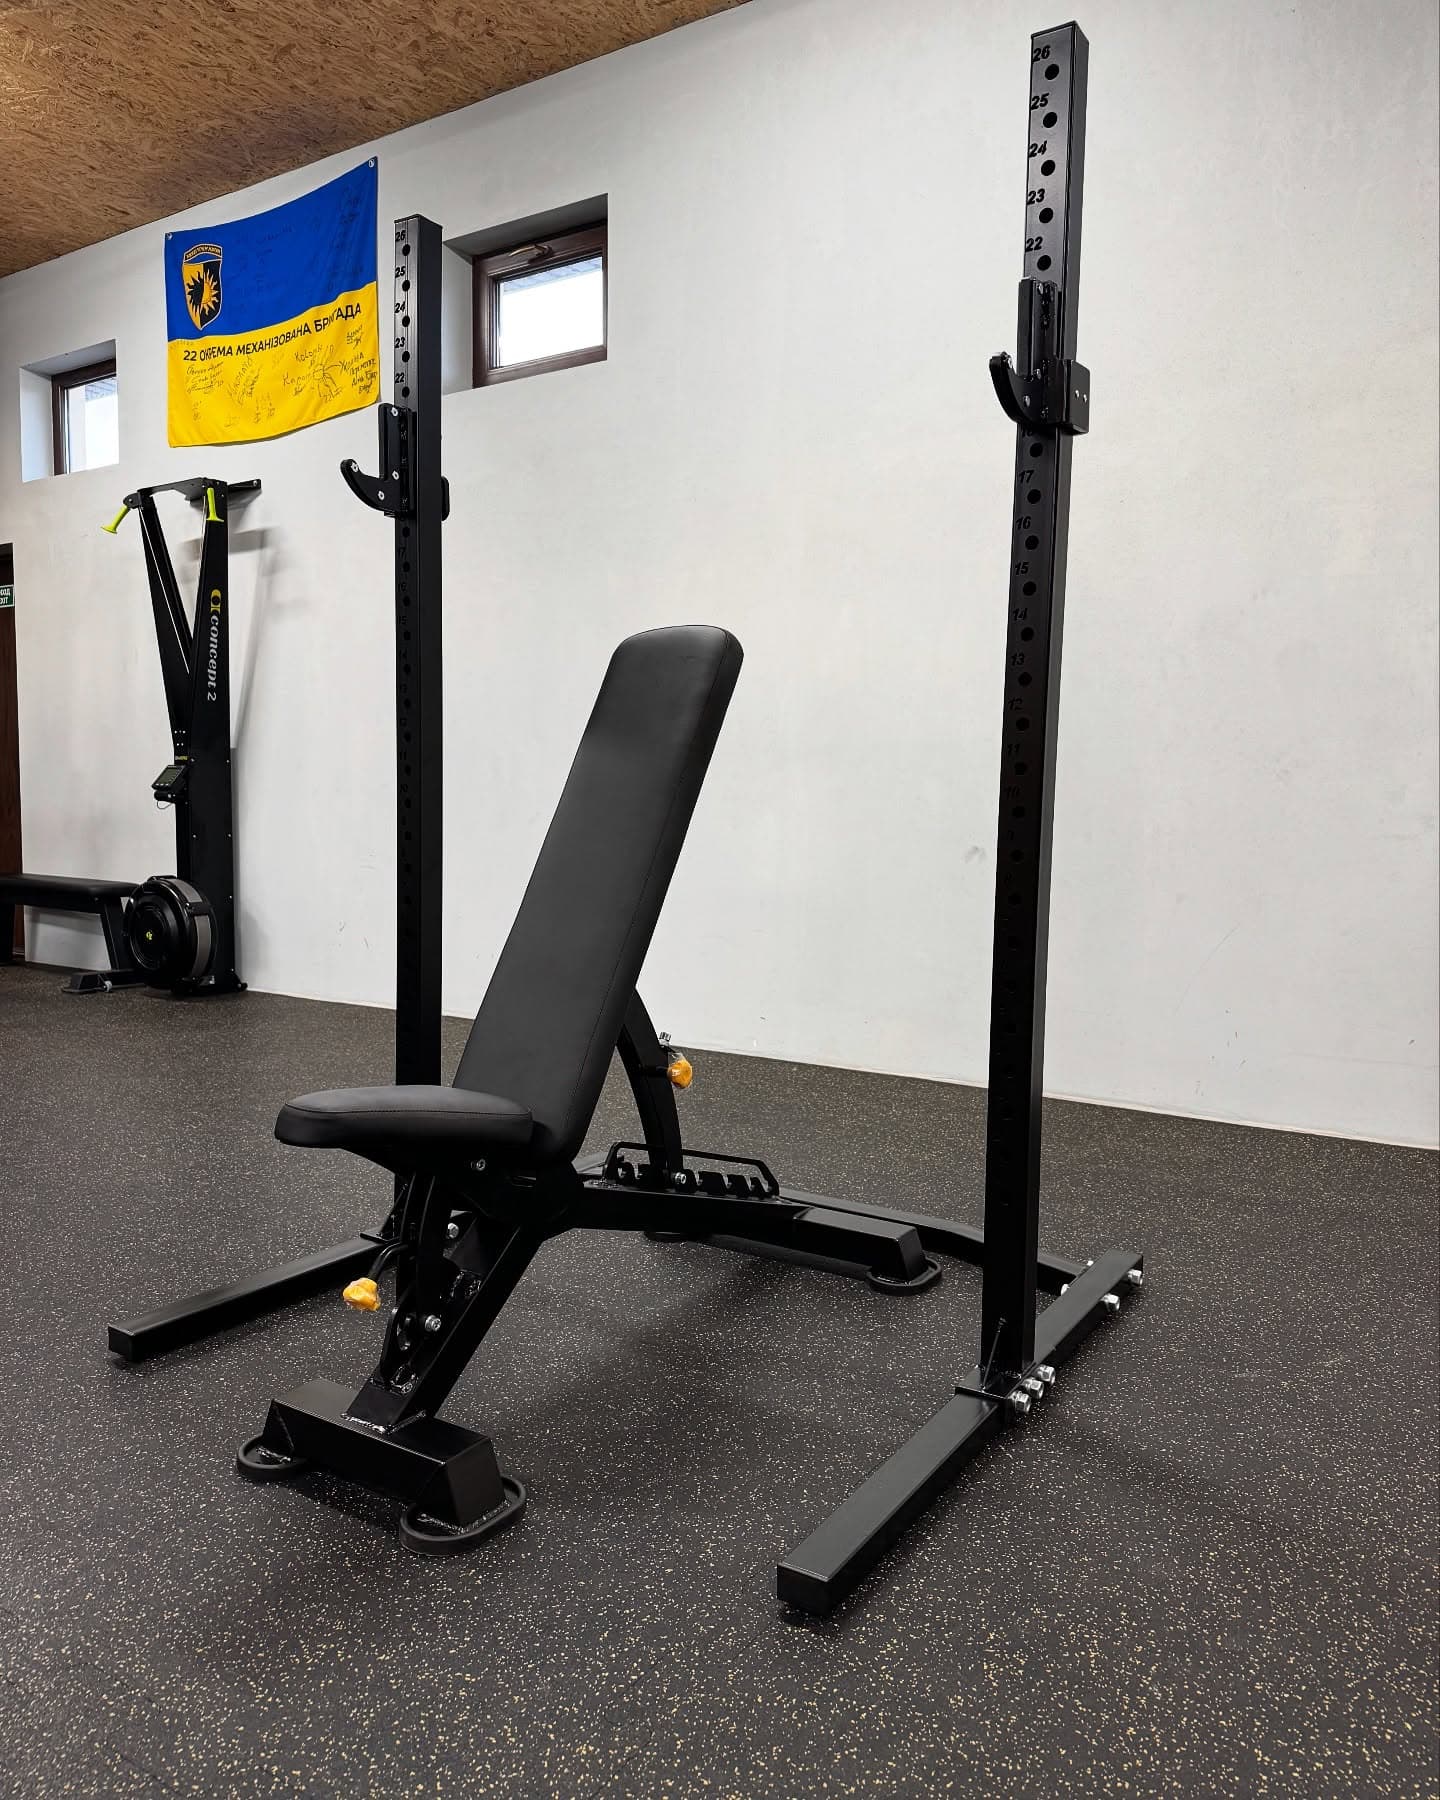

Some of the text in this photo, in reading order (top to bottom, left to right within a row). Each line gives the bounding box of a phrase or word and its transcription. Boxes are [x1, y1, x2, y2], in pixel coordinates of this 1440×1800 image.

[1032, 45, 1050, 62] 26
[1030, 93, 1050, 110] 25
[1028, 140, 1047, 158] 24
[1026, 188, 1045, 205] 23
[395, 230, 406, 242] 26
[1025, 236, 1043, 253] 22
[395, 266, 406, 278] 25
[394, 301, 406, 314] 24
[183, 350, 197, 361] 22
[199, 345, 233, 361] ОКРЕМА
[236, 322, 312, 355] МЕХАНІЗОВАНА
[314, 303, 361, 332] БРИГАДА
[394, 336, 406, 349] 23
[394, 372, 405, 384] 22
[1017, 469, 1034, 484] 17
[1015, 515, 1032, 530] 16
[1014, 561, 1029, 576] 15
[1012, 607, 1027, 622] 14
[207, 615, 219, 701] concept 2
[1010, 652, 1025, 667] 13
